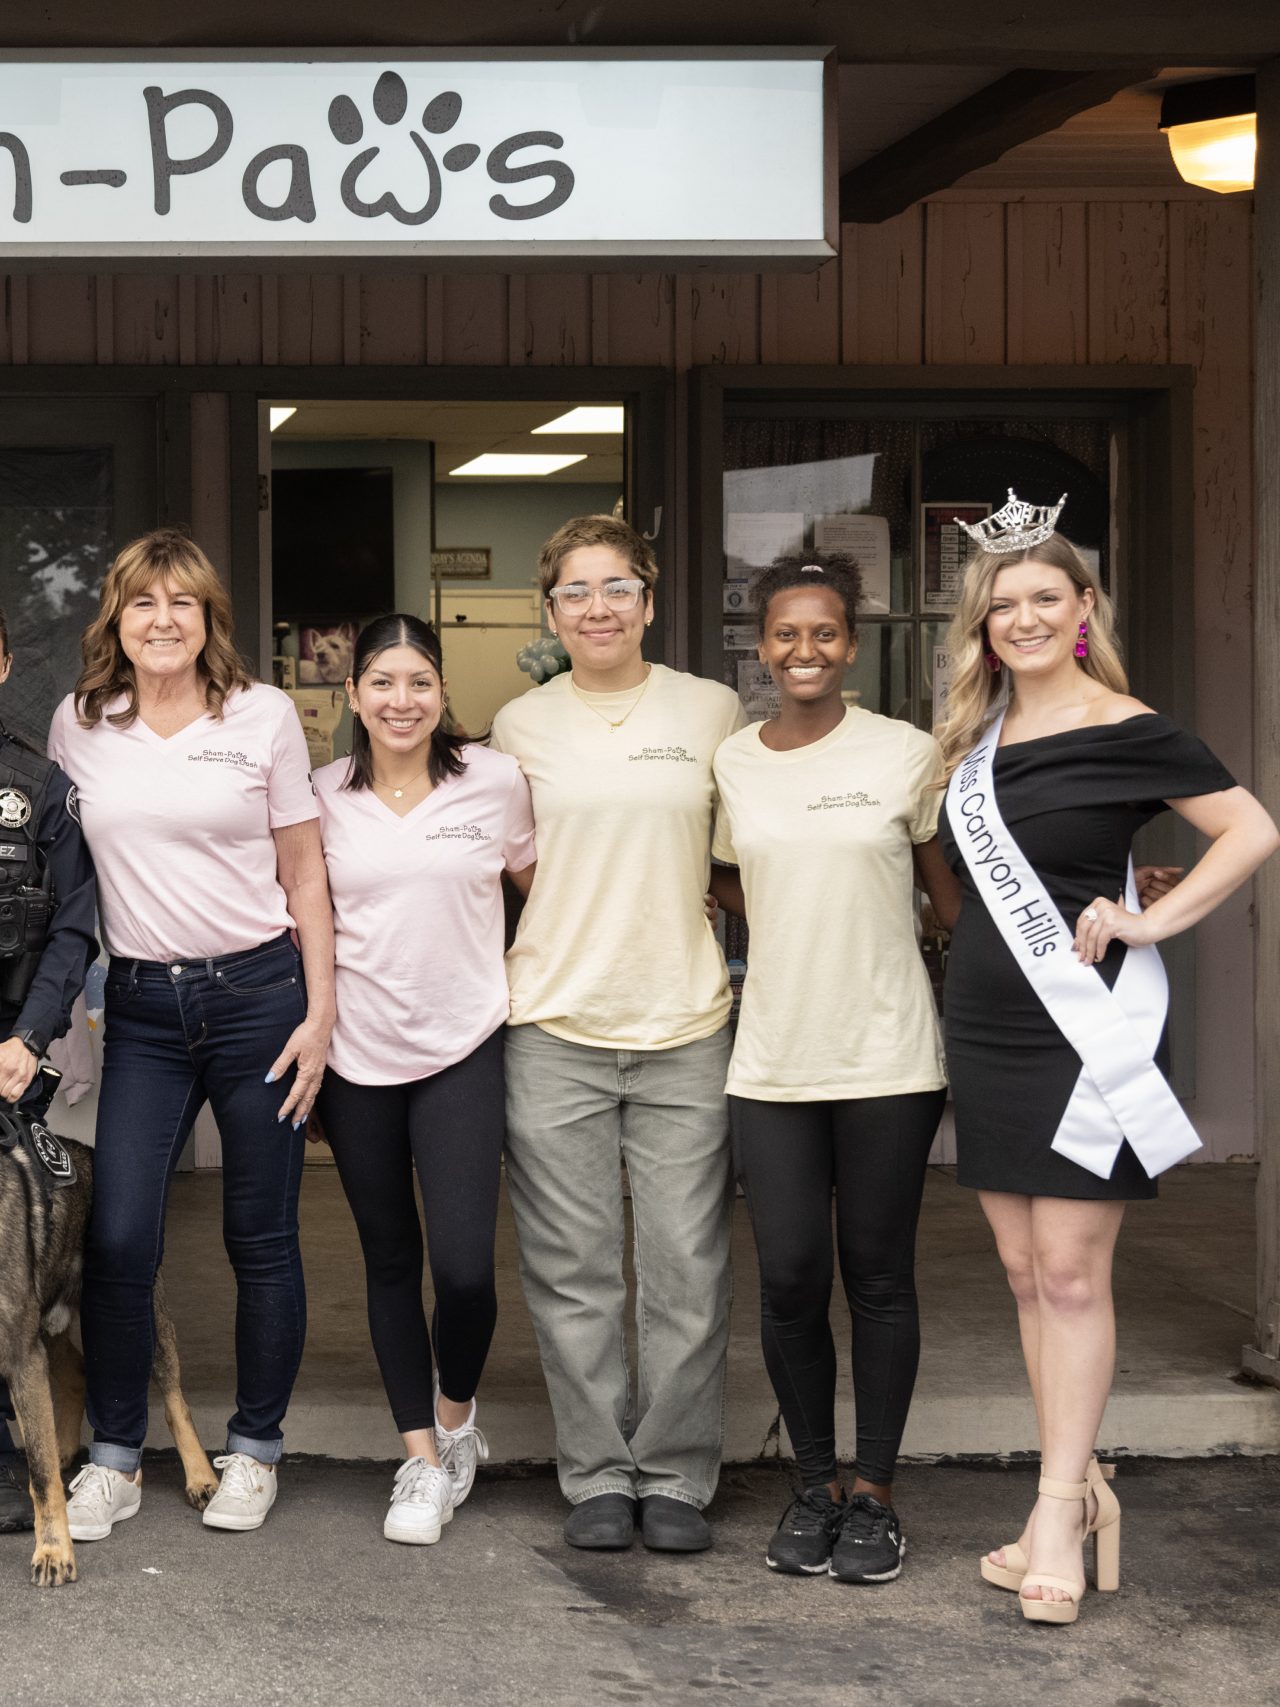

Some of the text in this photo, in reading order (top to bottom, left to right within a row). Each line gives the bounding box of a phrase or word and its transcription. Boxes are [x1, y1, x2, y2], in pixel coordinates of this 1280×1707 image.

[643, 506, 662, 540] J
[224, 757, 238, 765] Dog
[665, 753, 679, 762] Dog
[807, 803, 822, 811] Self
[823, 802, 844, 810] Serve
[845, 800, 859, 808] Dog
[462, 832, 475, 841] Dog
[960, 745, 1056, 958] Miss Canyon Hills
